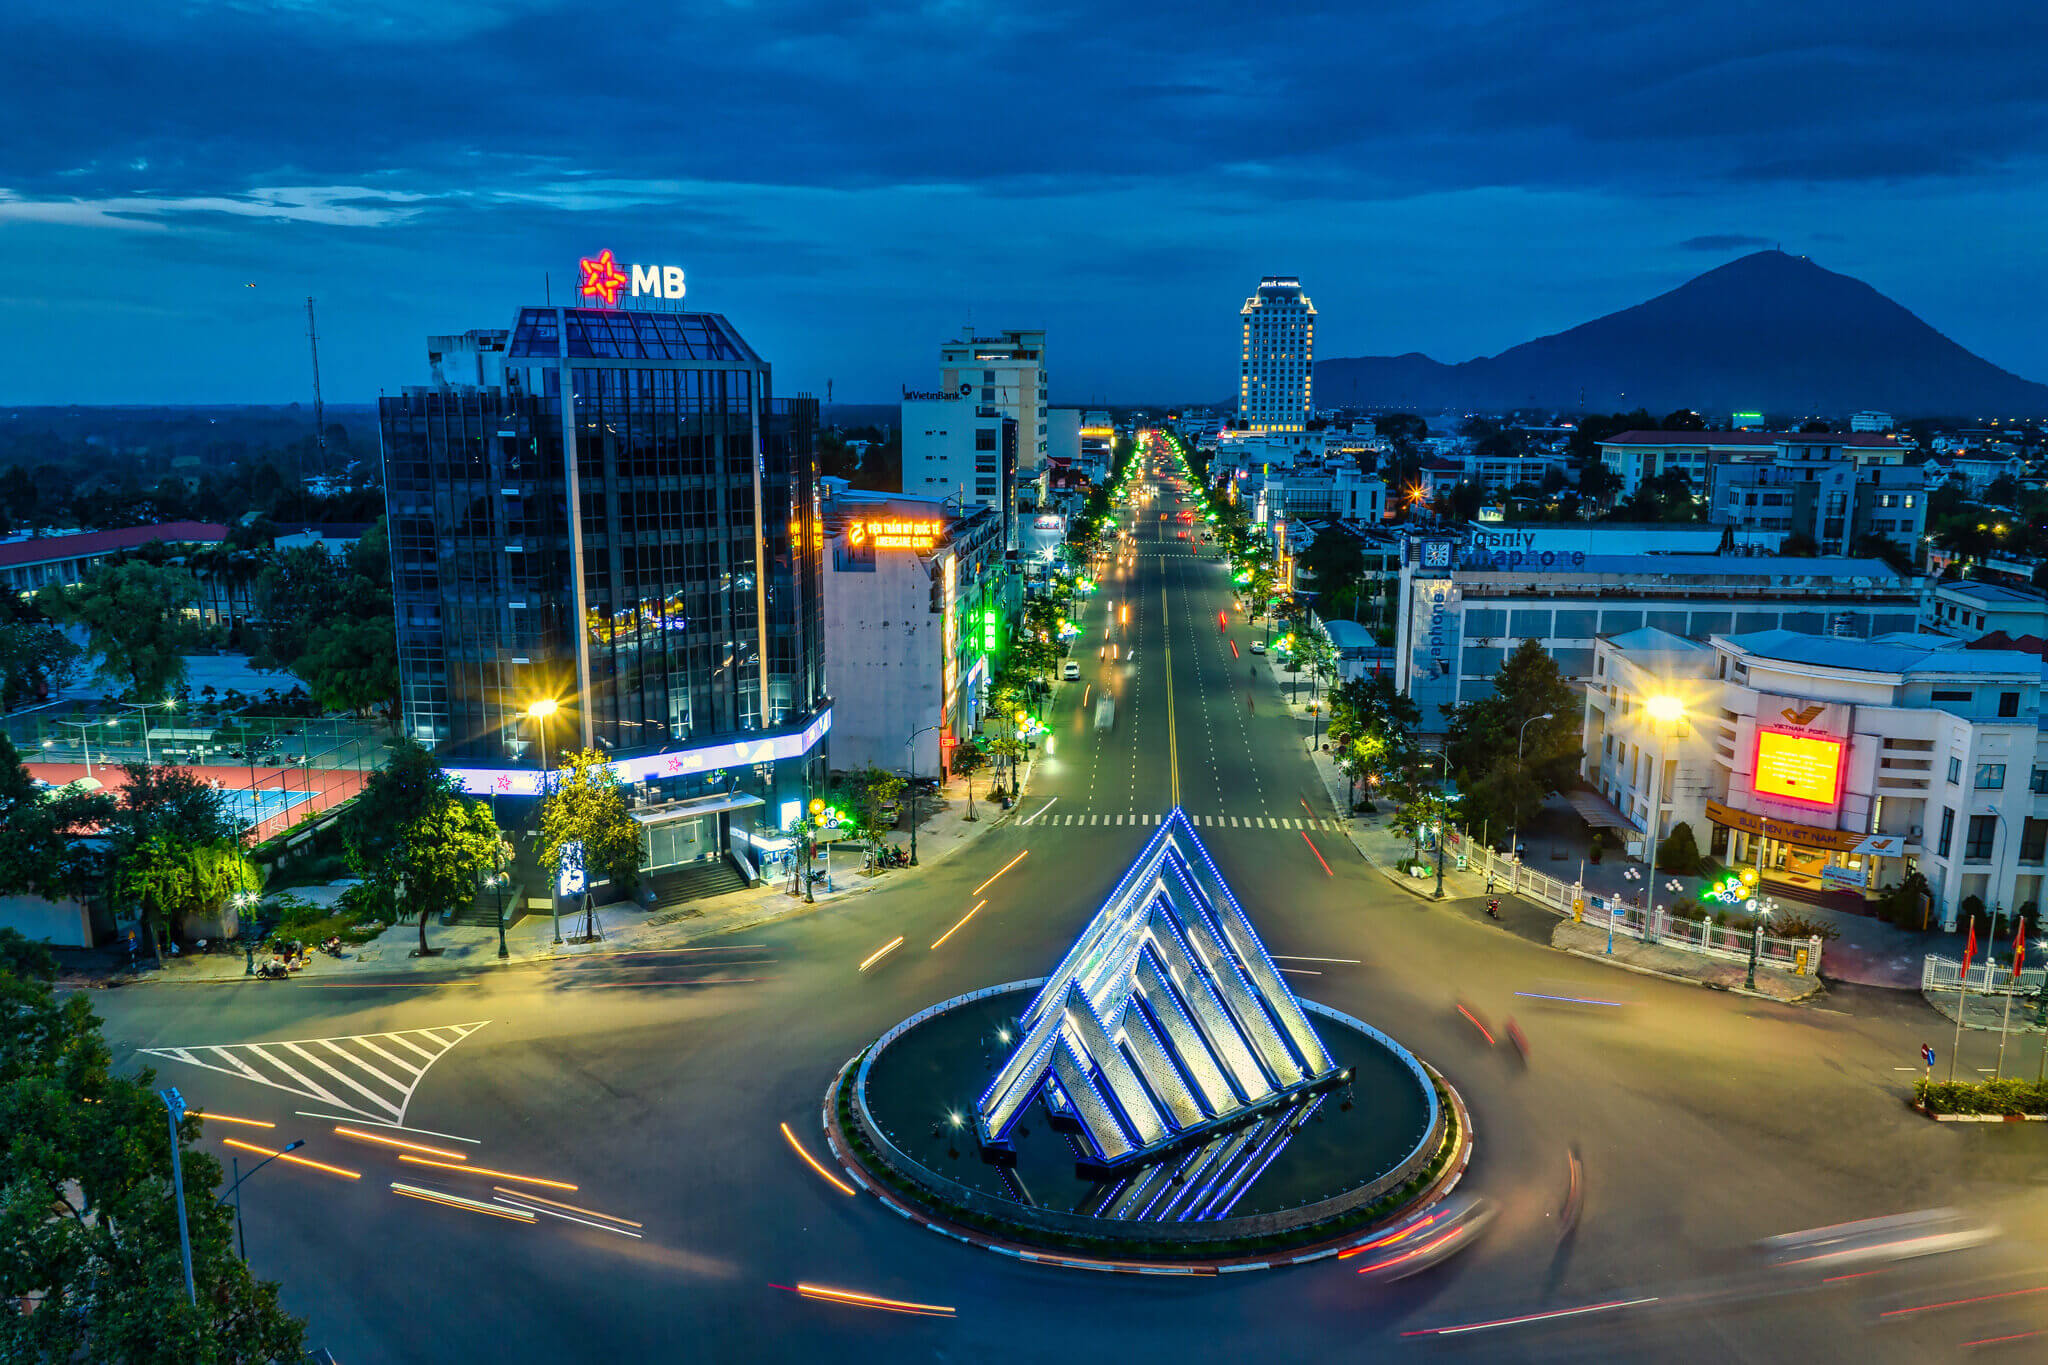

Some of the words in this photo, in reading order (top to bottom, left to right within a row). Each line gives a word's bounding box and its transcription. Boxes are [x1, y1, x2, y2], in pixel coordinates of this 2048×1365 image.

[632, 264, 686, 299] MB
[1458, 544, 1586, 571] vinaphone
[1773, 723, 1805, 732] VIETNAM
[1808, 728, 1828, 736] POST
[1811, 833, 1837, 844] NAM
